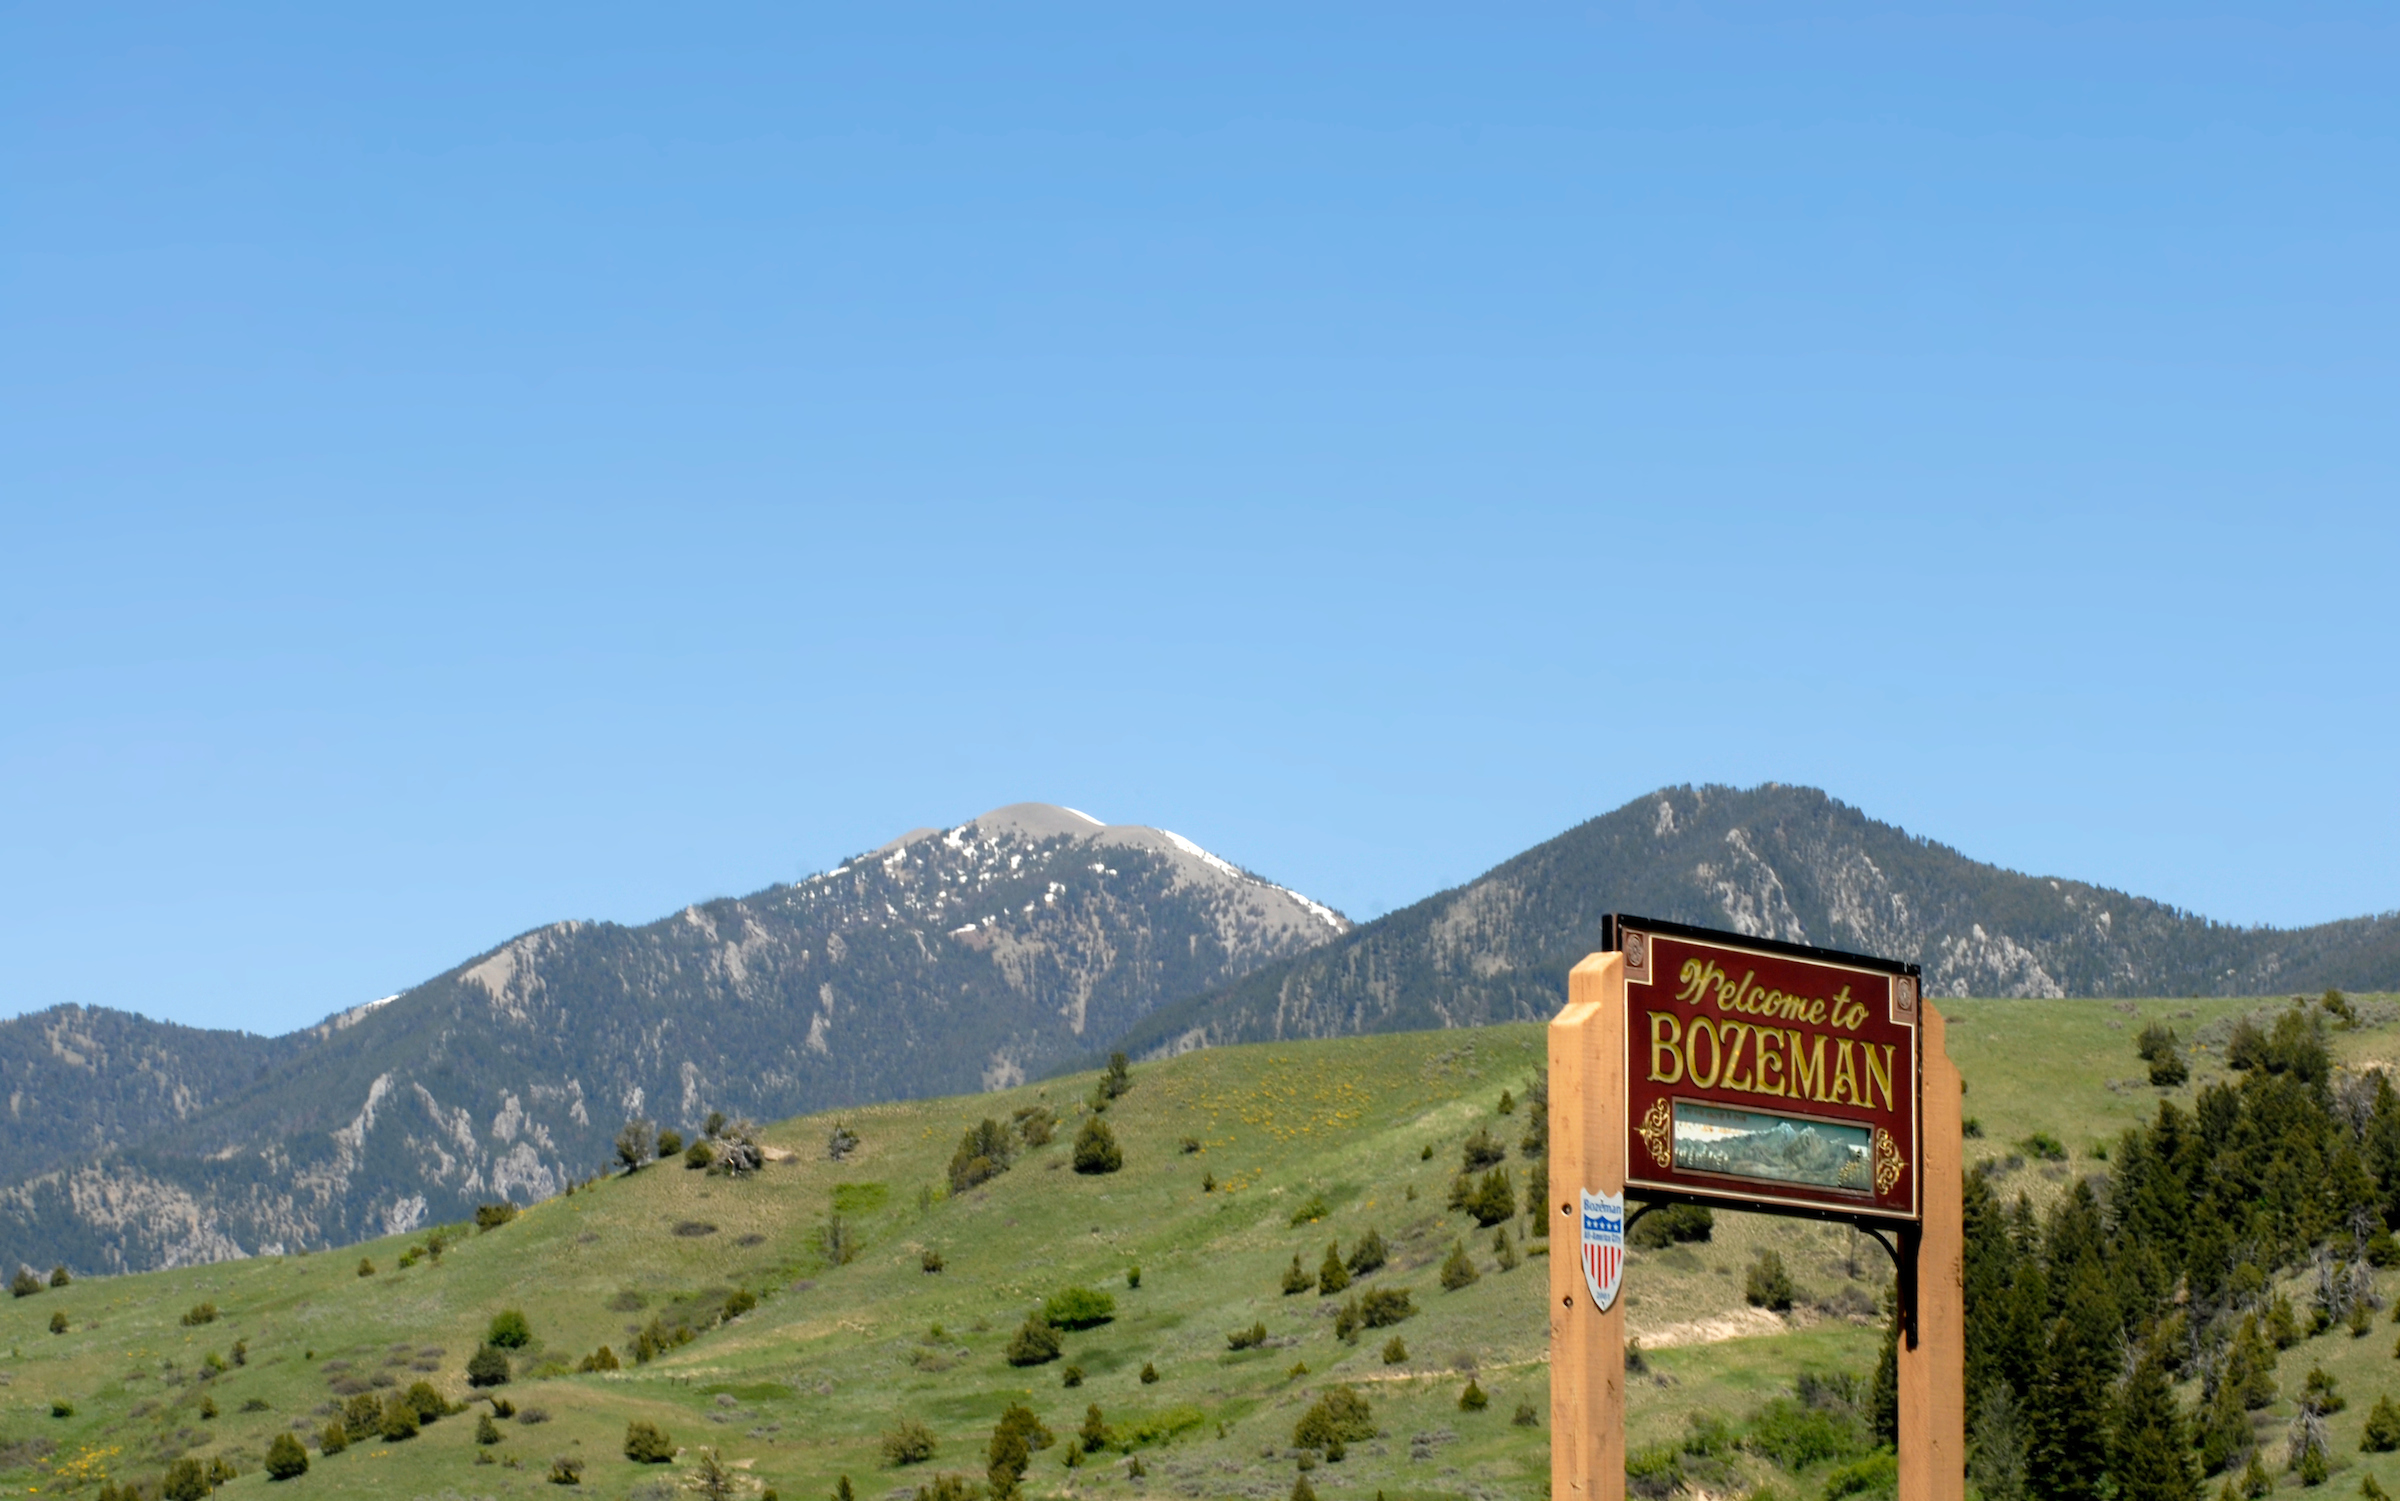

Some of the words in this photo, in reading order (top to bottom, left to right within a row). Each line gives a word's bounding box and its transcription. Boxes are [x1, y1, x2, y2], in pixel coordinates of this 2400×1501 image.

[1675, 957, 1827, 1025] Welcome
[1831, 985, 1870, 1031] to
[1646, 1010, 1897, 1113] BOZEMAN
[1583, 1198, 1622, 1214] Bozeman
